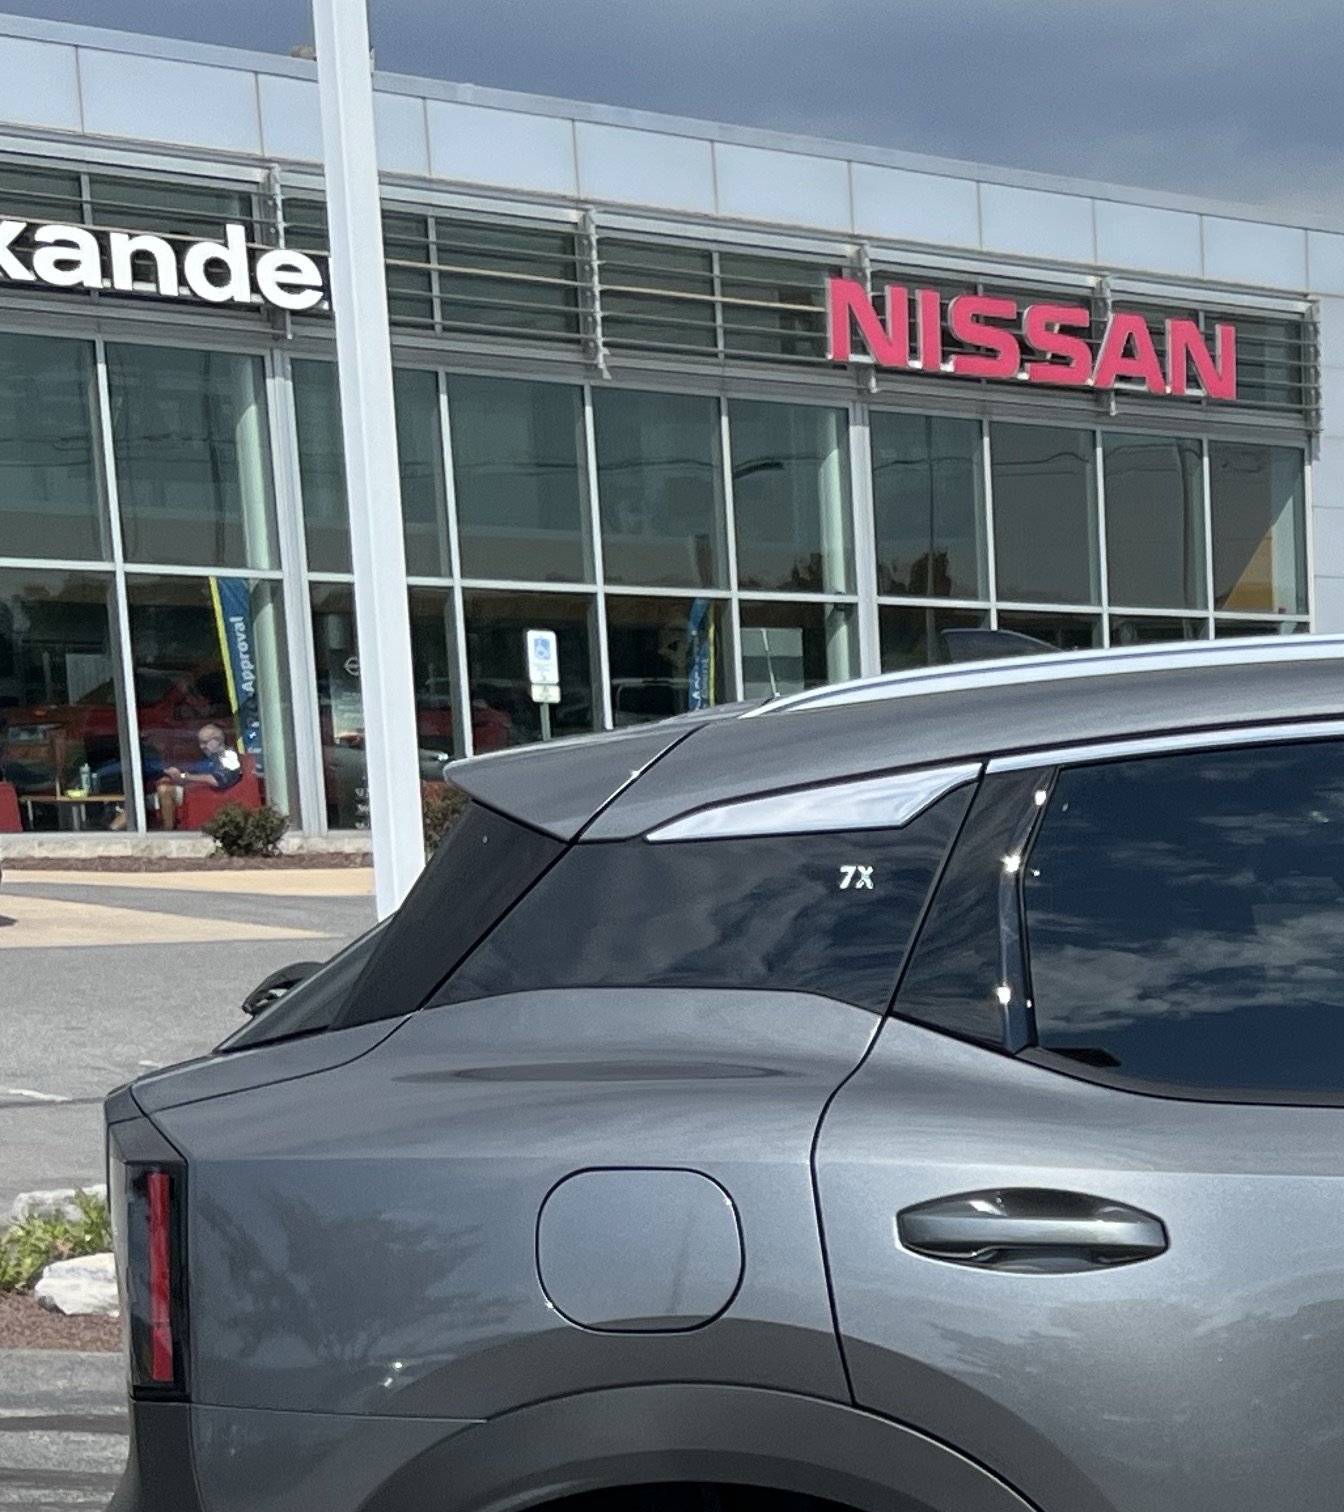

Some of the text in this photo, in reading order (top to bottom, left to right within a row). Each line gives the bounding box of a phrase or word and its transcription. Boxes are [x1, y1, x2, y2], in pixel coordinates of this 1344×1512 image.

[826, 276, 1237, 401] NISSAN
[229, 615, 256, 693] Approval
[839, 864, 875, 890] 7X
